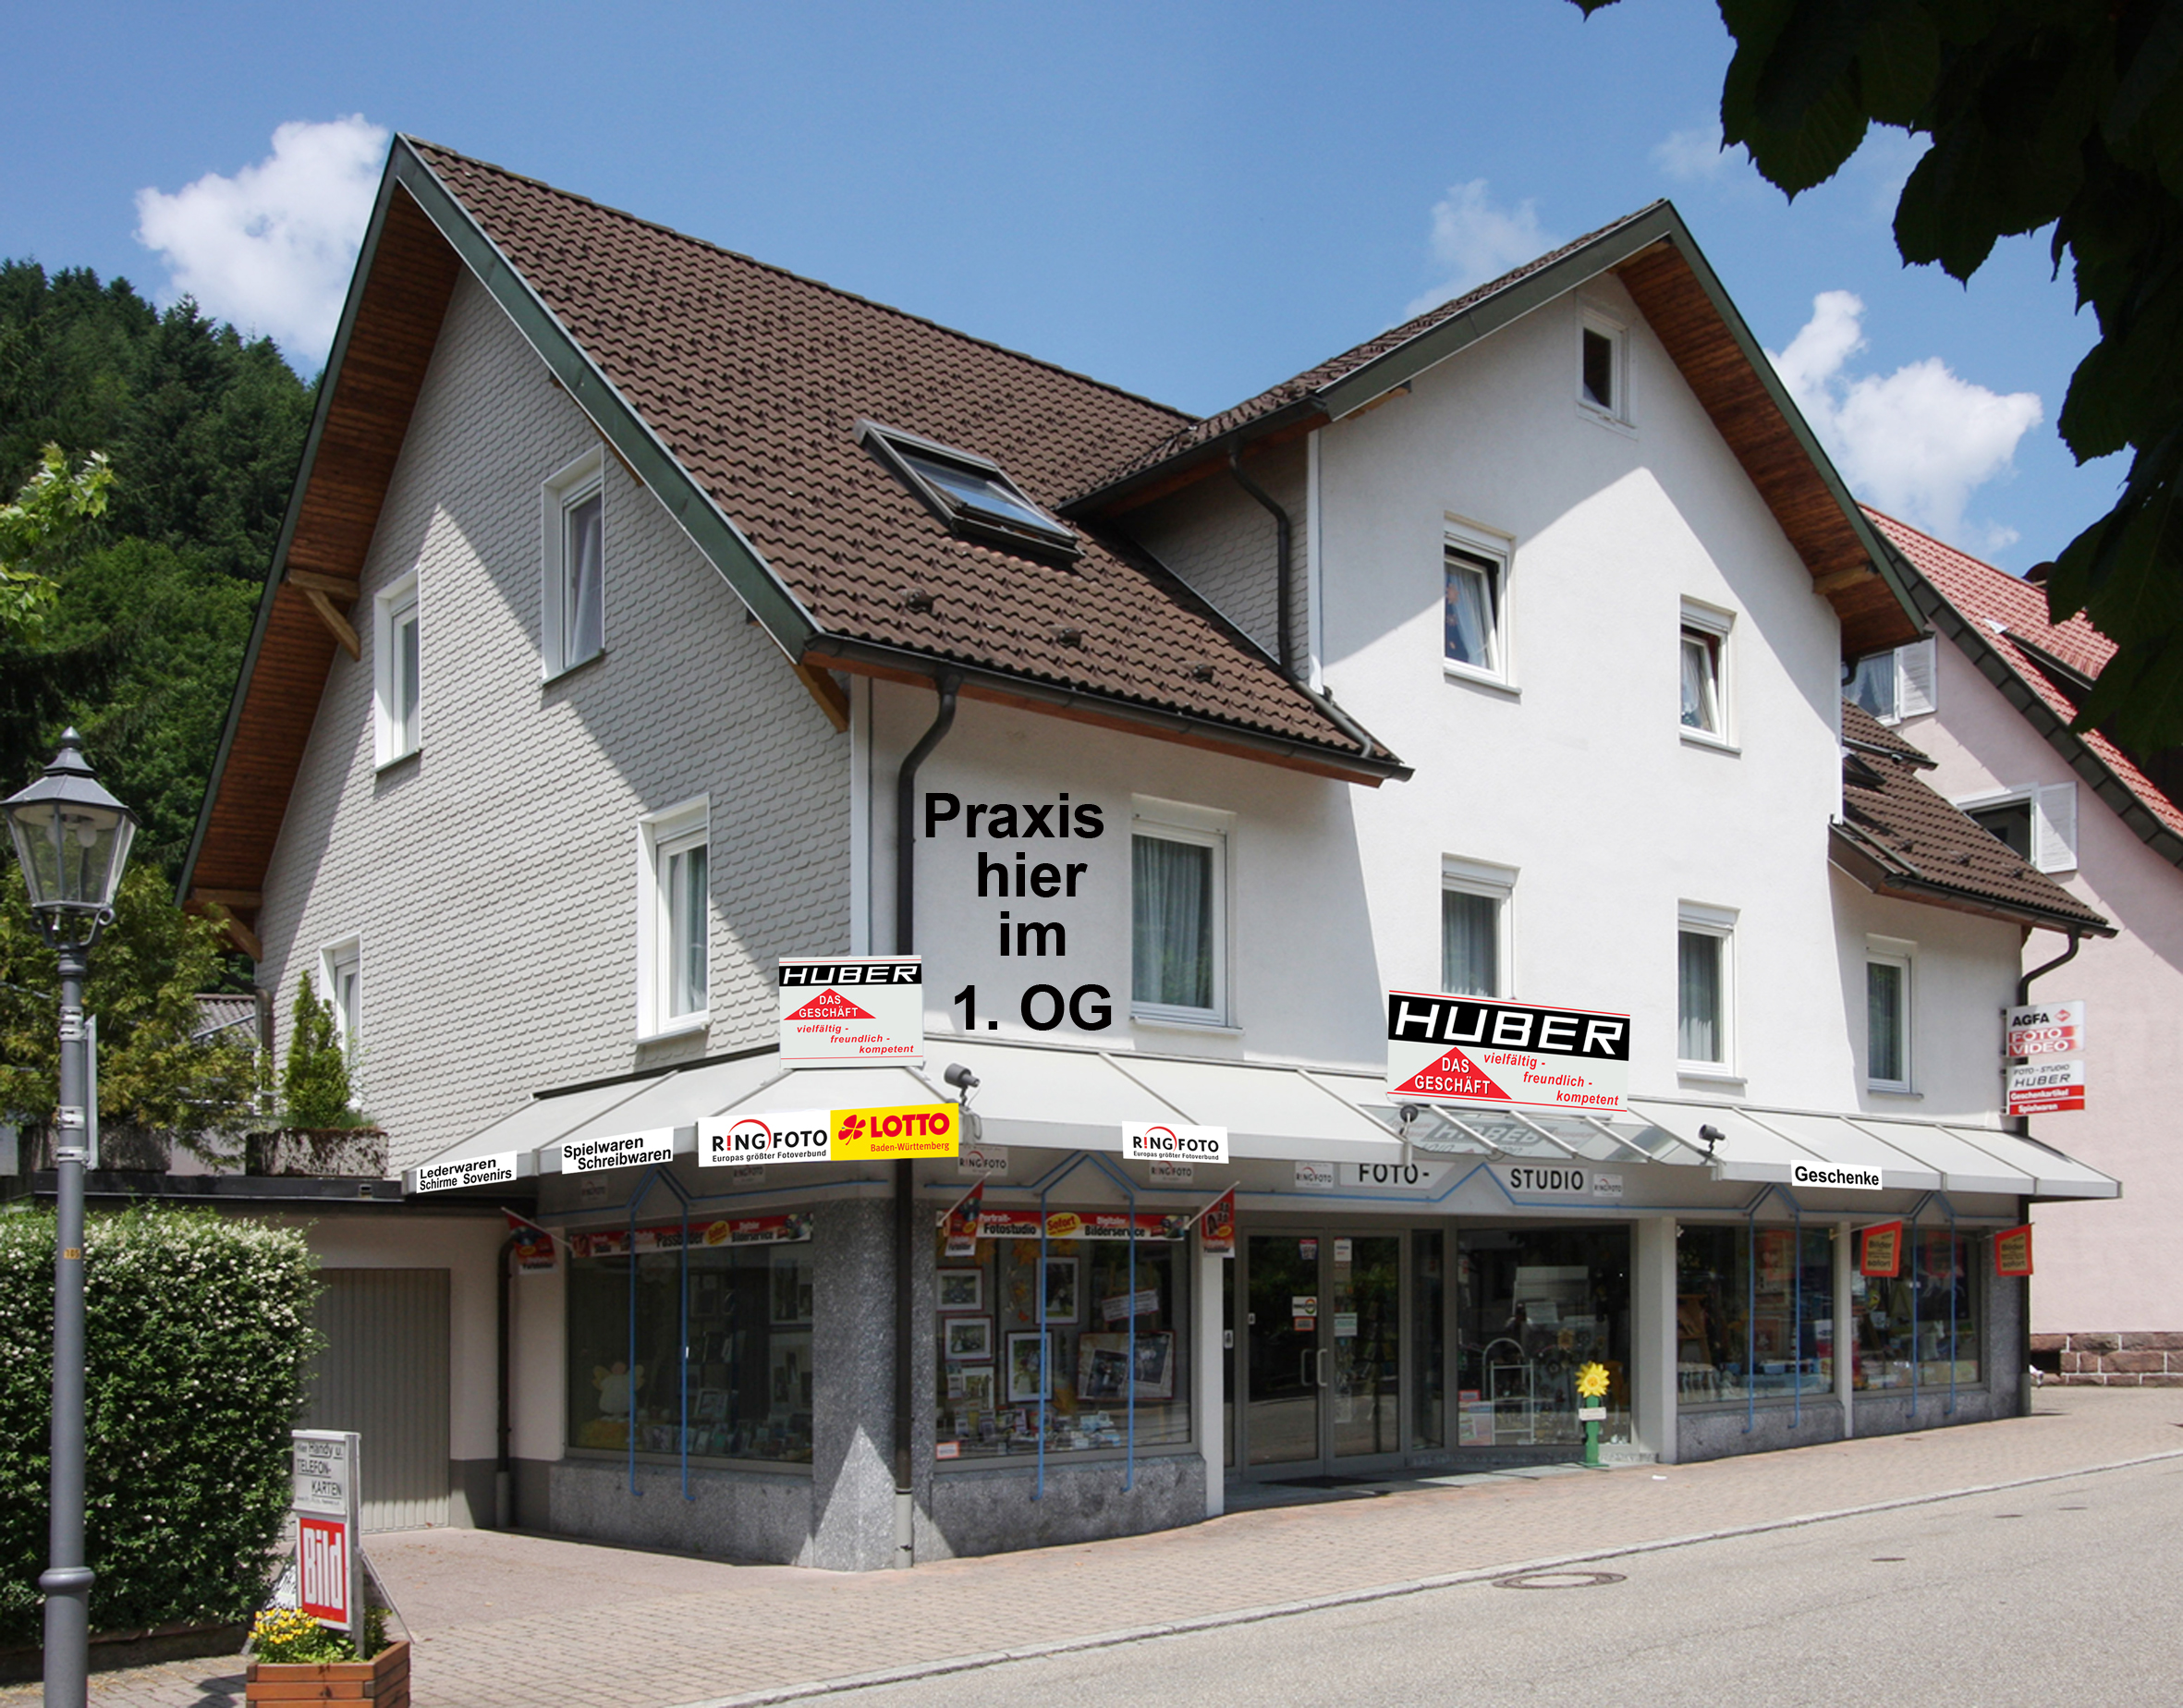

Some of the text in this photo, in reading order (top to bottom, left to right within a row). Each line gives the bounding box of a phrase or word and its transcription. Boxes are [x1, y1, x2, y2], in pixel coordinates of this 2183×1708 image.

[783, 965, 919, 985] HUBER
[820, 994, 841, 1006] DAS
[799, 1006, 859, 1019] GESCHÄFT
[2012, 1013, 2050, 1027] AGFA
[797, 1024, 842, 1035] vielfältig
[1395, 1001, 1624, 1055] HUBER
[2012, 1028, 2062, 1043] FOTO
[830, 1034, 884, 1043] freundlich
[859, 1044, 914, 1055] kompetent
[2011, 1040, 2068, 1055] VIDEO
[1442, 1057, 1470, 1073] DAS
[1483, 1052, 1538, 1069] vielfältig
[2042, 1064, 2069, 1073] STUDIO
[1414, 1074, 1491, 1094] GESCHÄFT
[1523, 1071, 1585, 1088] freundlich
[2015, 1073, 2070, 1087] HUBER
[1555, 1090, 1619, 1106] kompetent
[2018, 1103, 2058, 1114] Spielwaren
[871, 1112, 950, 1138] LOTTO
[563, 1136, 644, 1160] Spielwaren
[871, 1141, 950, 1153] Baden-Württemberg
[578, 1147, 672, 1170] Schreibwaren
[713, 1150, 826, 1163] Europas größter Fotoverbund
[421, 1158, 496, 1179] Lederwaren
[1794, 1165, 1879, 1186] Geschenke
[420, 1168, 512, 1190] Schirme Sovenirs
[1510, 1168, 1583, 1190] STUDIO
[983, 1222, 1036, 1236] Fotostudio
[1046, 1215, 1076, 1231] Sofort
[1085, 1226, 1145, 1237] Bilderservce
[311, 1480, 342, 1495] KARTEN
[303, 1527, 343, 1610] Bild
